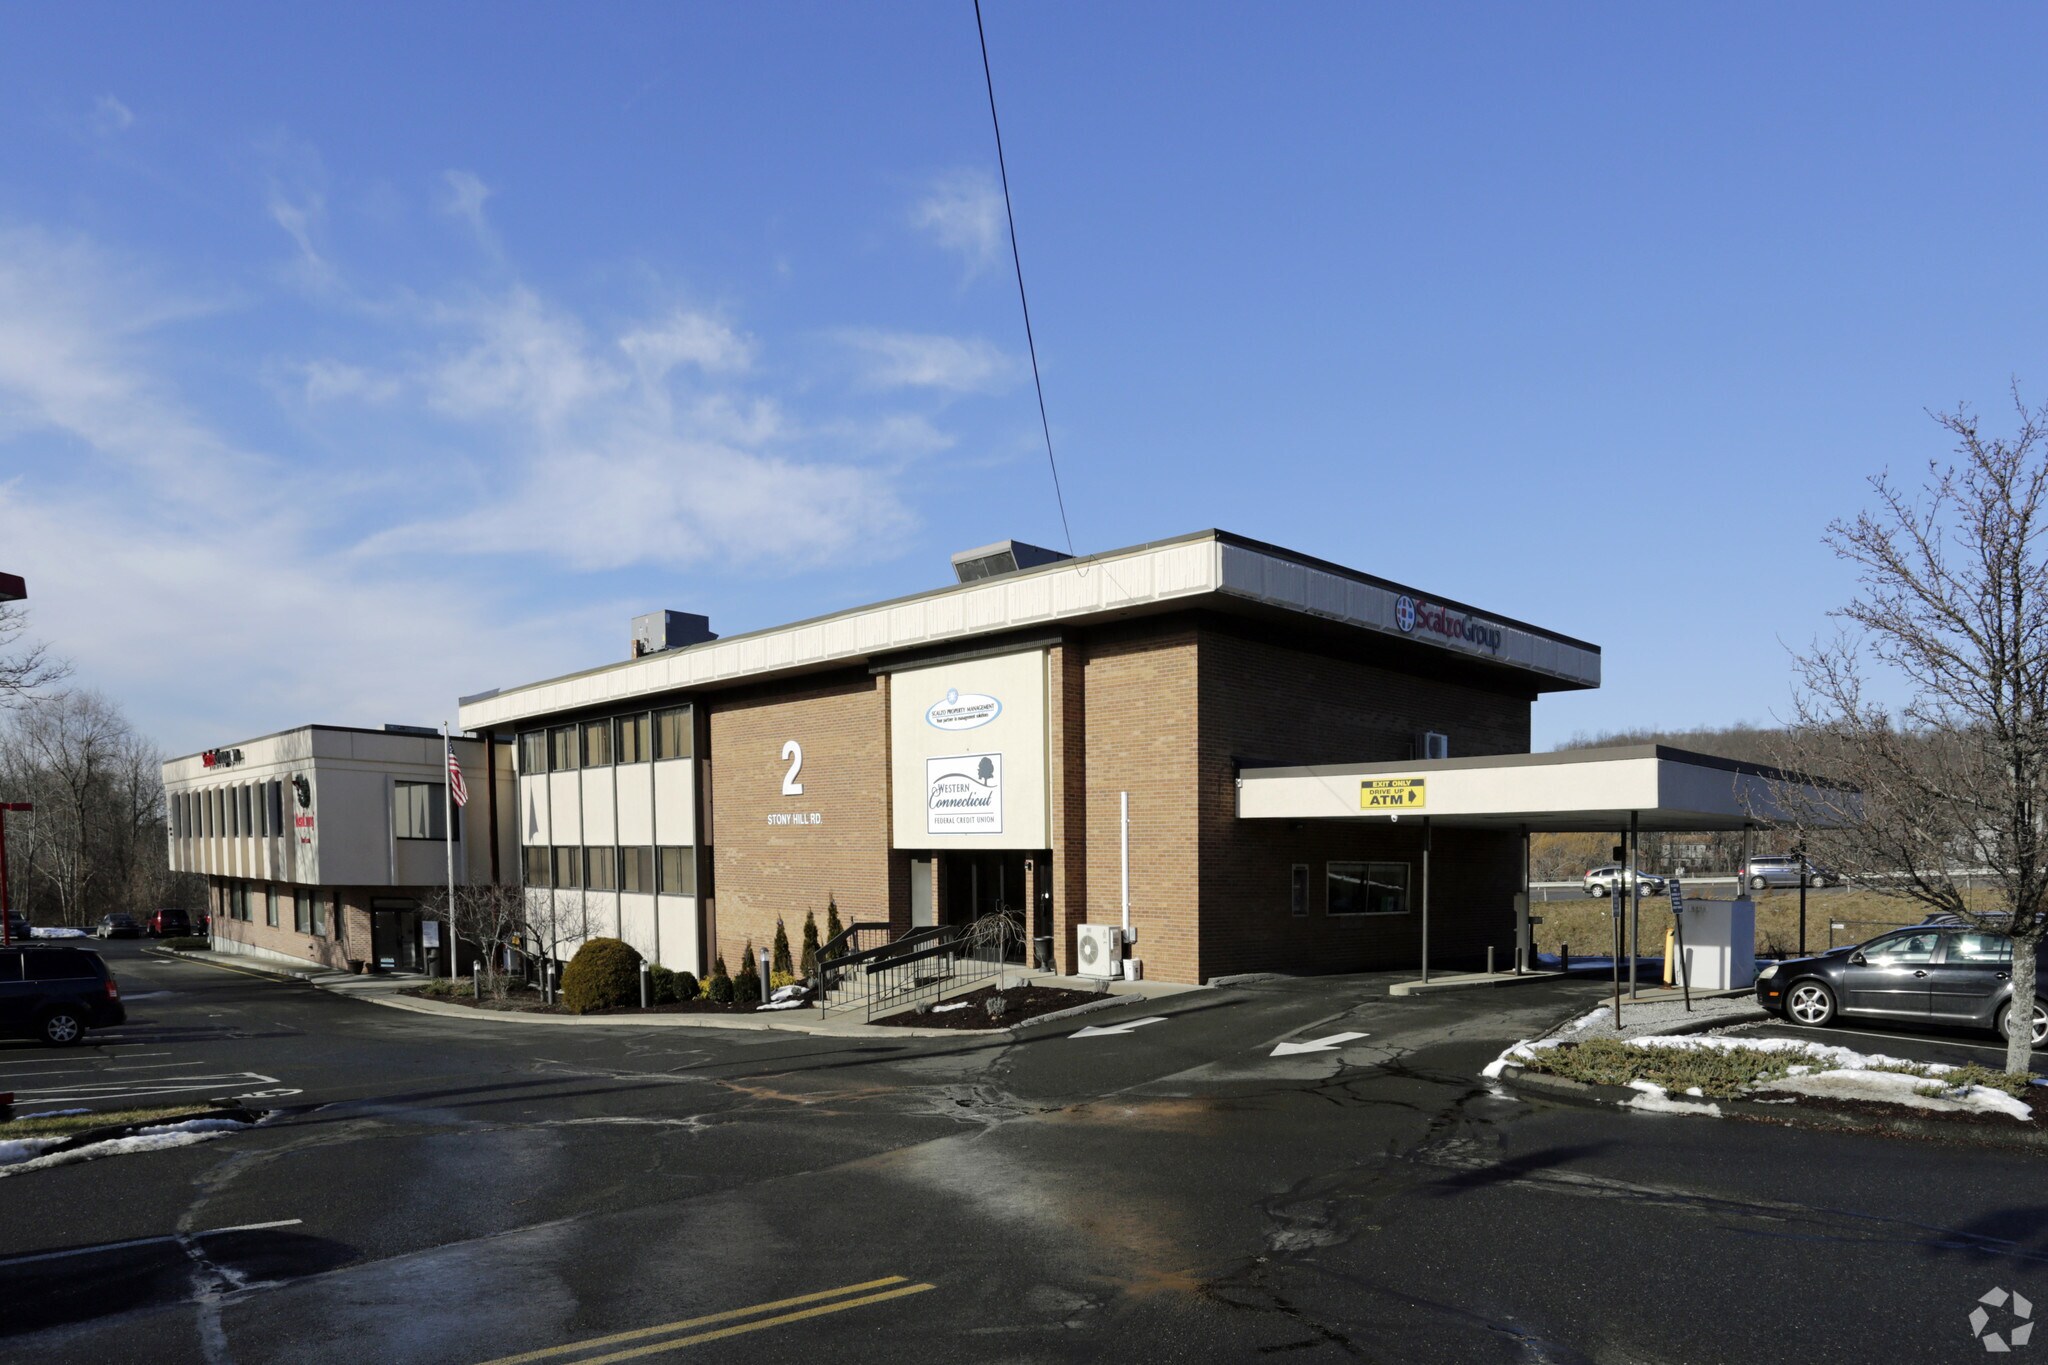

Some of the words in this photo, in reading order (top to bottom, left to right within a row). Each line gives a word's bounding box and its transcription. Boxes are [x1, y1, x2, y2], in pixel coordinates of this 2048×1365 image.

[967, 703, 994, 711] MANAGEMENT
[781, 740, 803, 796] 2
[937, 783, 970, 793] WESTERN
[929, 787, 993, 809] Connecticut
[1369, 795, 1403, 805] ATM
[767, 814, 791, 825] STONY
[792, 814, 809, 825] HILL
[810, 813, 824, 825] RD.
[956, 816, 975, 824] CREDIT
[976, 815, 995, 823] UNION
